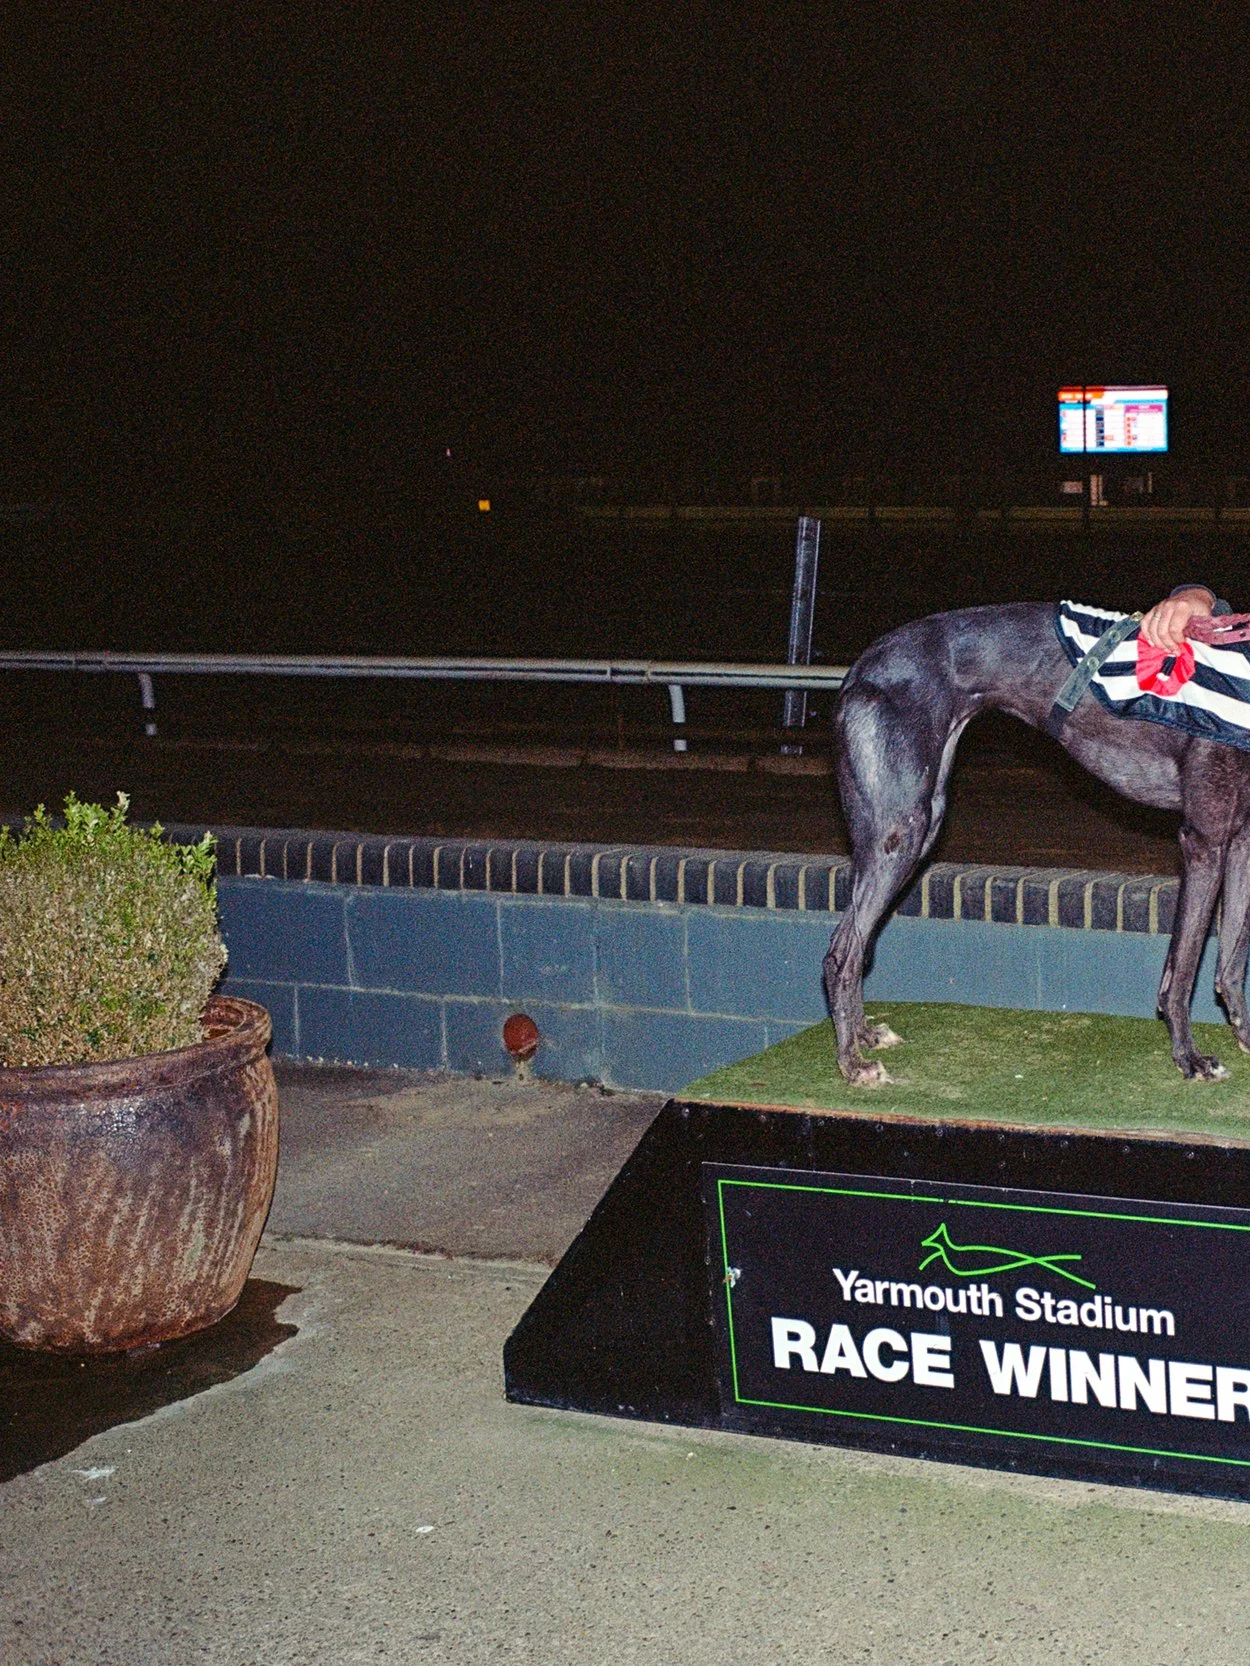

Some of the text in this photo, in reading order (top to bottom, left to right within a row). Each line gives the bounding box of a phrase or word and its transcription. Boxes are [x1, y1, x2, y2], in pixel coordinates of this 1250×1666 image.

[832, 1268, 1176, 1337] Yarmouth Stadium
[770, 1316, 955, 1389] RACE
